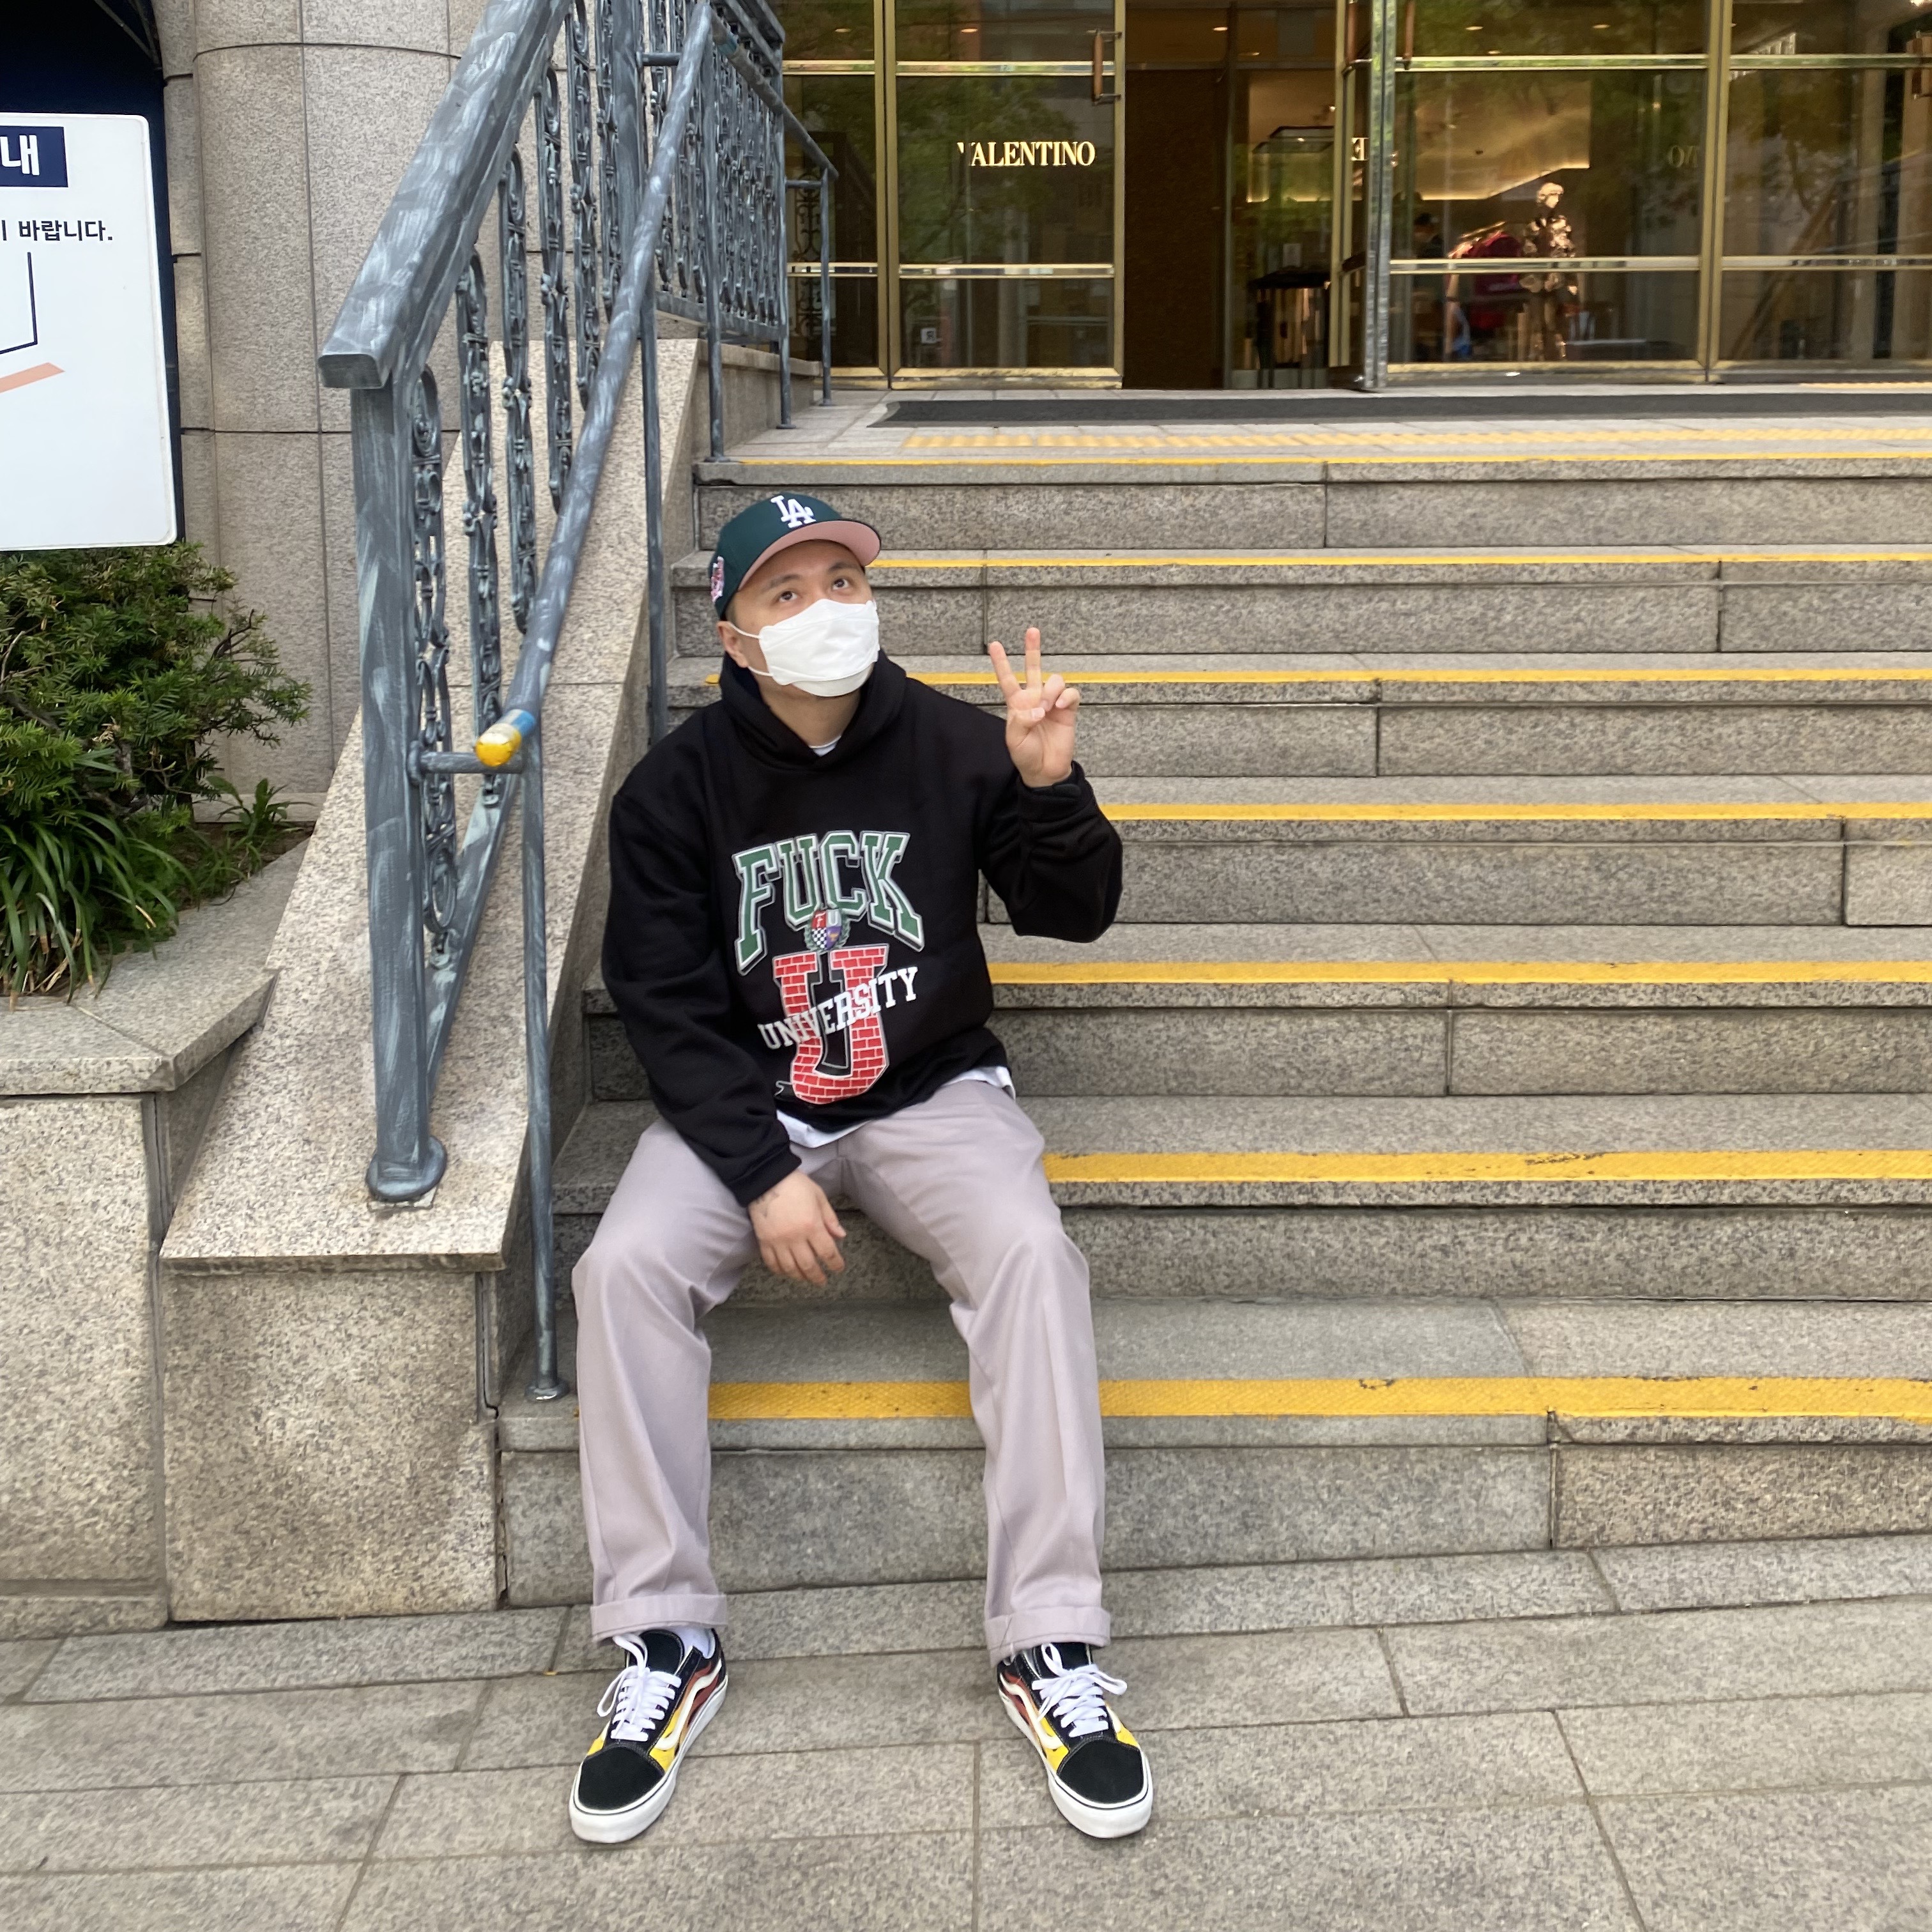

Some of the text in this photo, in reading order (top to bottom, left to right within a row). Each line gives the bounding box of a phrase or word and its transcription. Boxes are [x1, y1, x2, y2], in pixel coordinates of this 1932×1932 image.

[19, 220, 112, 241] 바랍니다.
[771, 495, 816, 528] LA
[732, 831, 924, 976] FUCK
[758, 966, 918, 1050] UNIVERSITY
